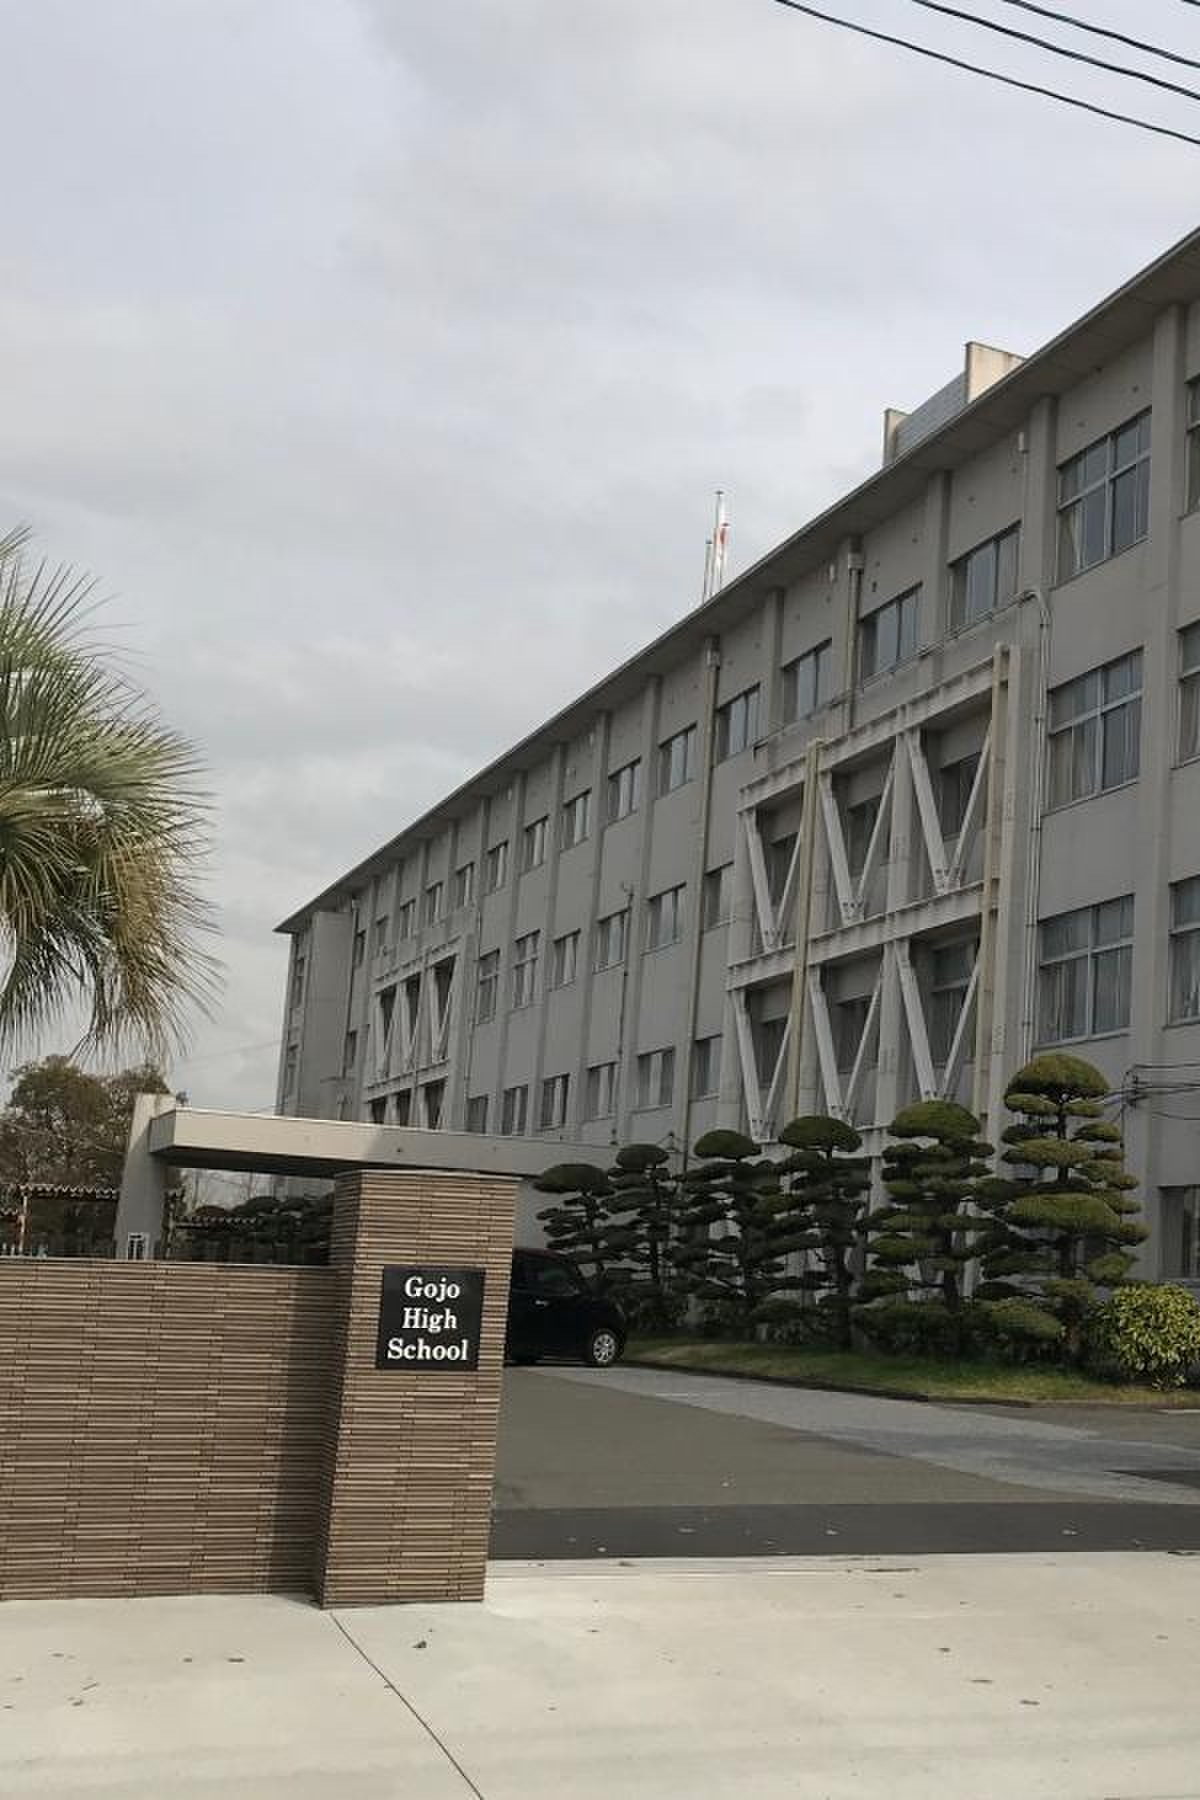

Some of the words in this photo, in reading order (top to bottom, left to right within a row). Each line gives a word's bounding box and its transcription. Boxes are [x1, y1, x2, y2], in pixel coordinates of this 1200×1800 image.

[404, 1275, 461, 1303] Gojo
[401, 1306, 458, 1334] High
[387, 1337, 469, 1361] School
